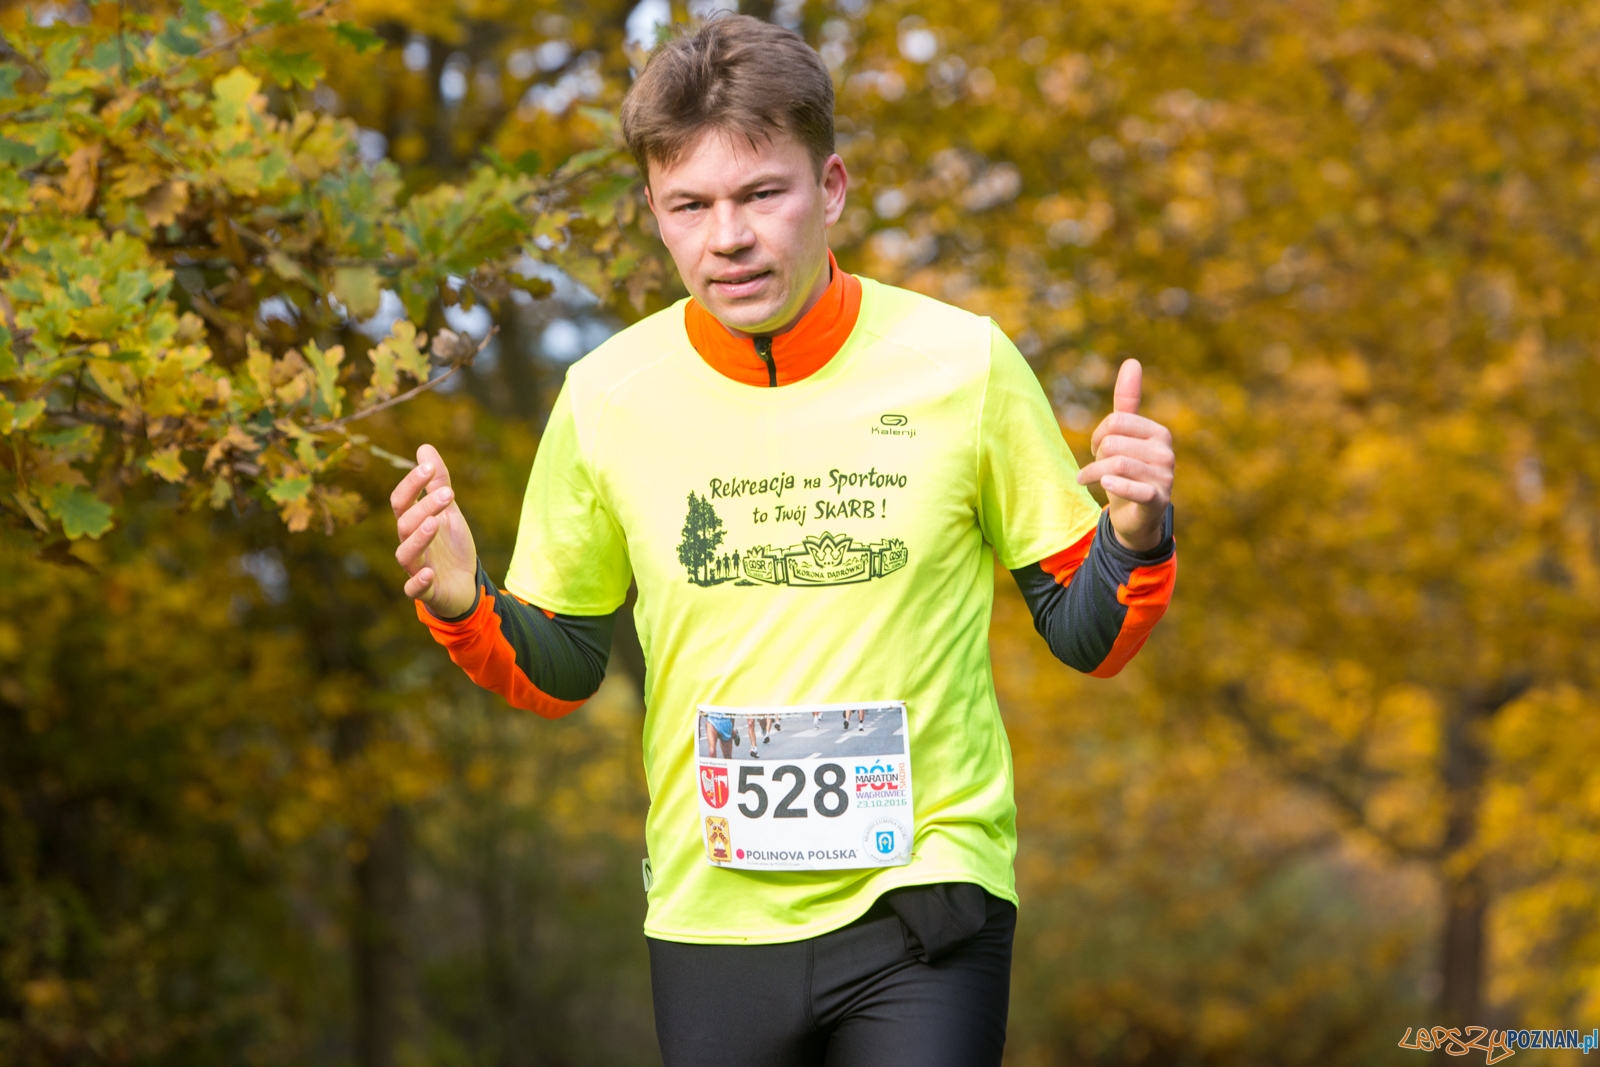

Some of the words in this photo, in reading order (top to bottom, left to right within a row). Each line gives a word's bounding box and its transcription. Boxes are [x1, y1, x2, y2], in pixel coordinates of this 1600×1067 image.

[871, 426, 916, 438] Kalenji
[709, 472, 795, 499] Rekreacja
[803, 477, 821, 489] na
[828, 467, 908, 495] Sportowo
[753, 507, 768, 524] to
[775, 505, 807, 527] Twój
[796, 568, 825, 579] KORONA
[855, 773, 899, 783] MARATON
[737, 763, 849, 819] 528
[855, 790, 906, 800] WĄGROWIEC
[856, 799, 907, 809] 23.10.2016
[746, 850, 805, 861] POLINOVA
[808, 849, 857, 860] POLSKA
